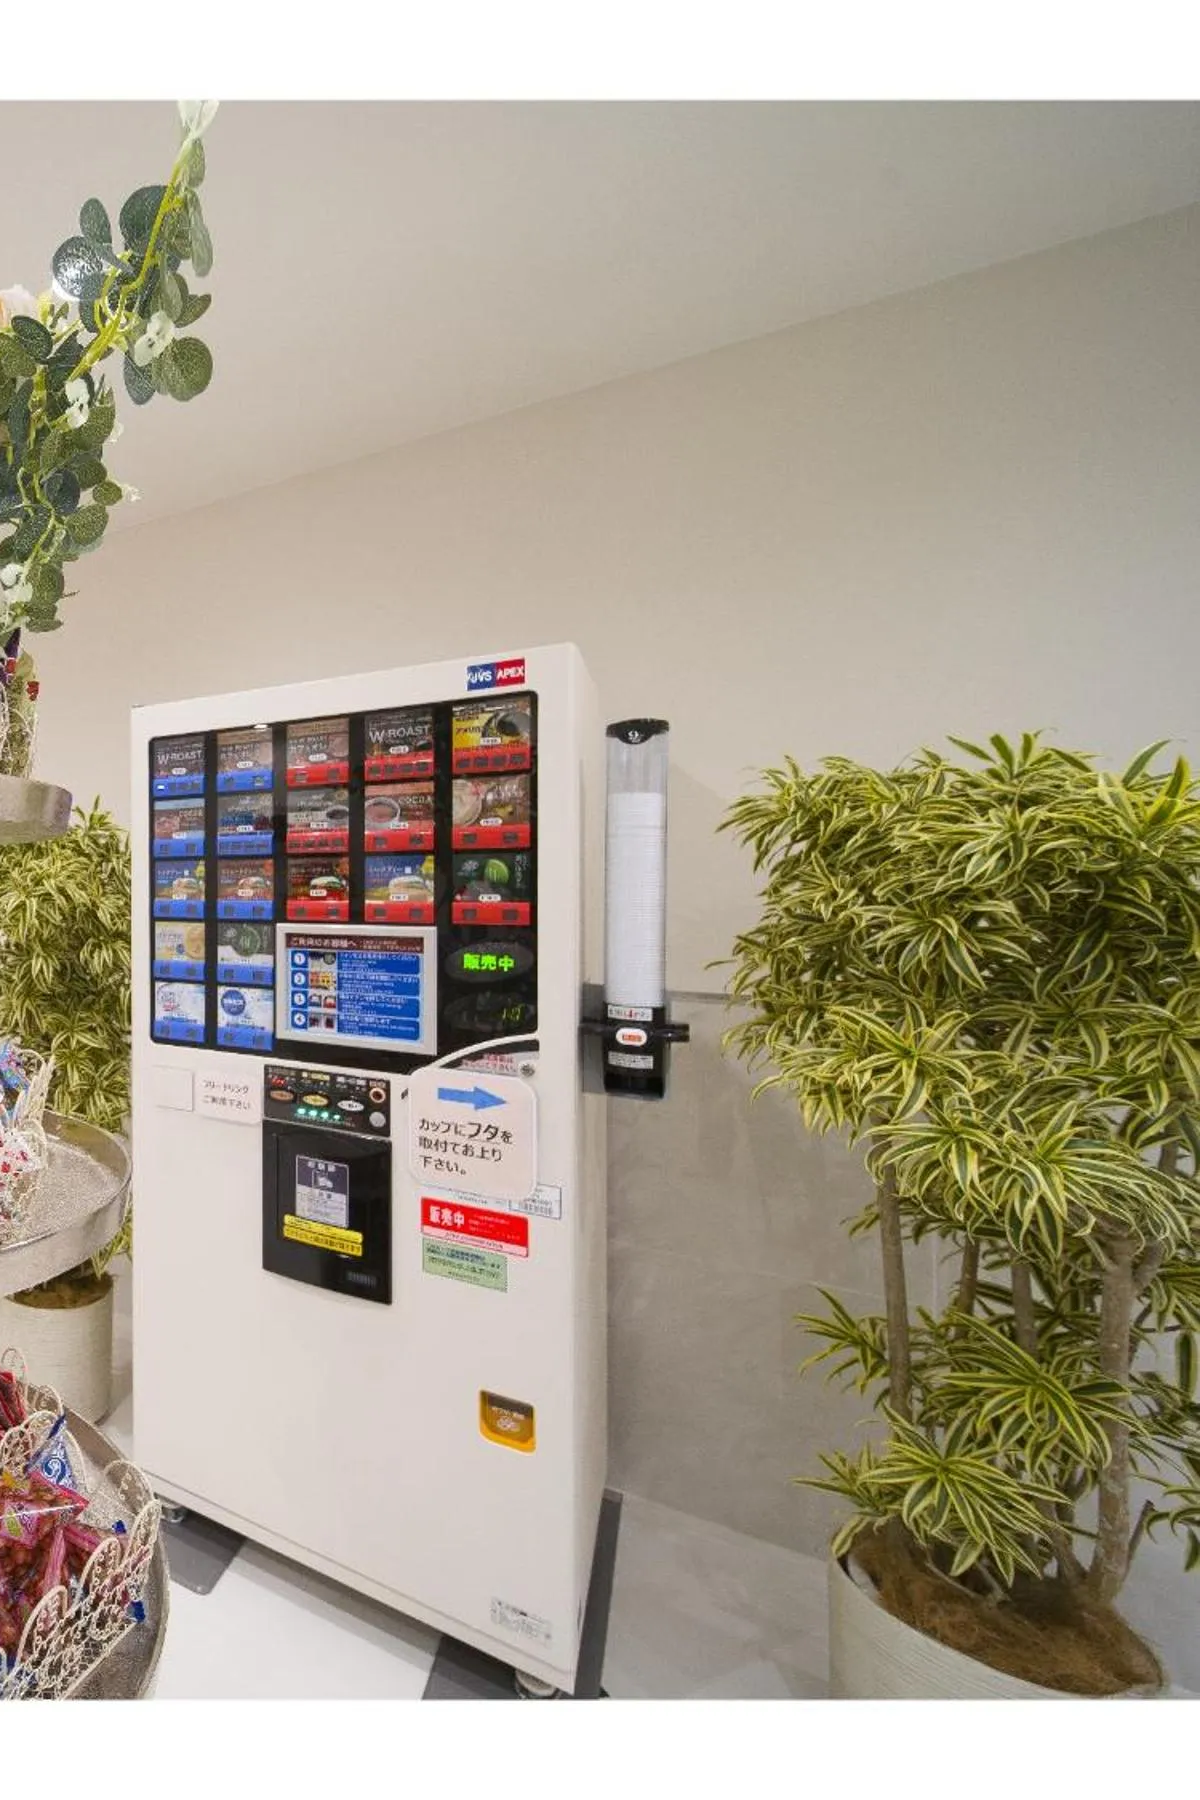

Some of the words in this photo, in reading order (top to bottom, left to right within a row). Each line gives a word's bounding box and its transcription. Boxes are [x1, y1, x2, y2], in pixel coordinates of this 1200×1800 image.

[497, 665, 524, 680] APEX
[463, 953, 515, 972] 販売中
[418, 1118, 513, 1144] カップにフタを
[418, 1136, 502, 1162] 取付てお上り
[429, 1205, 465, 1229] 販売中
